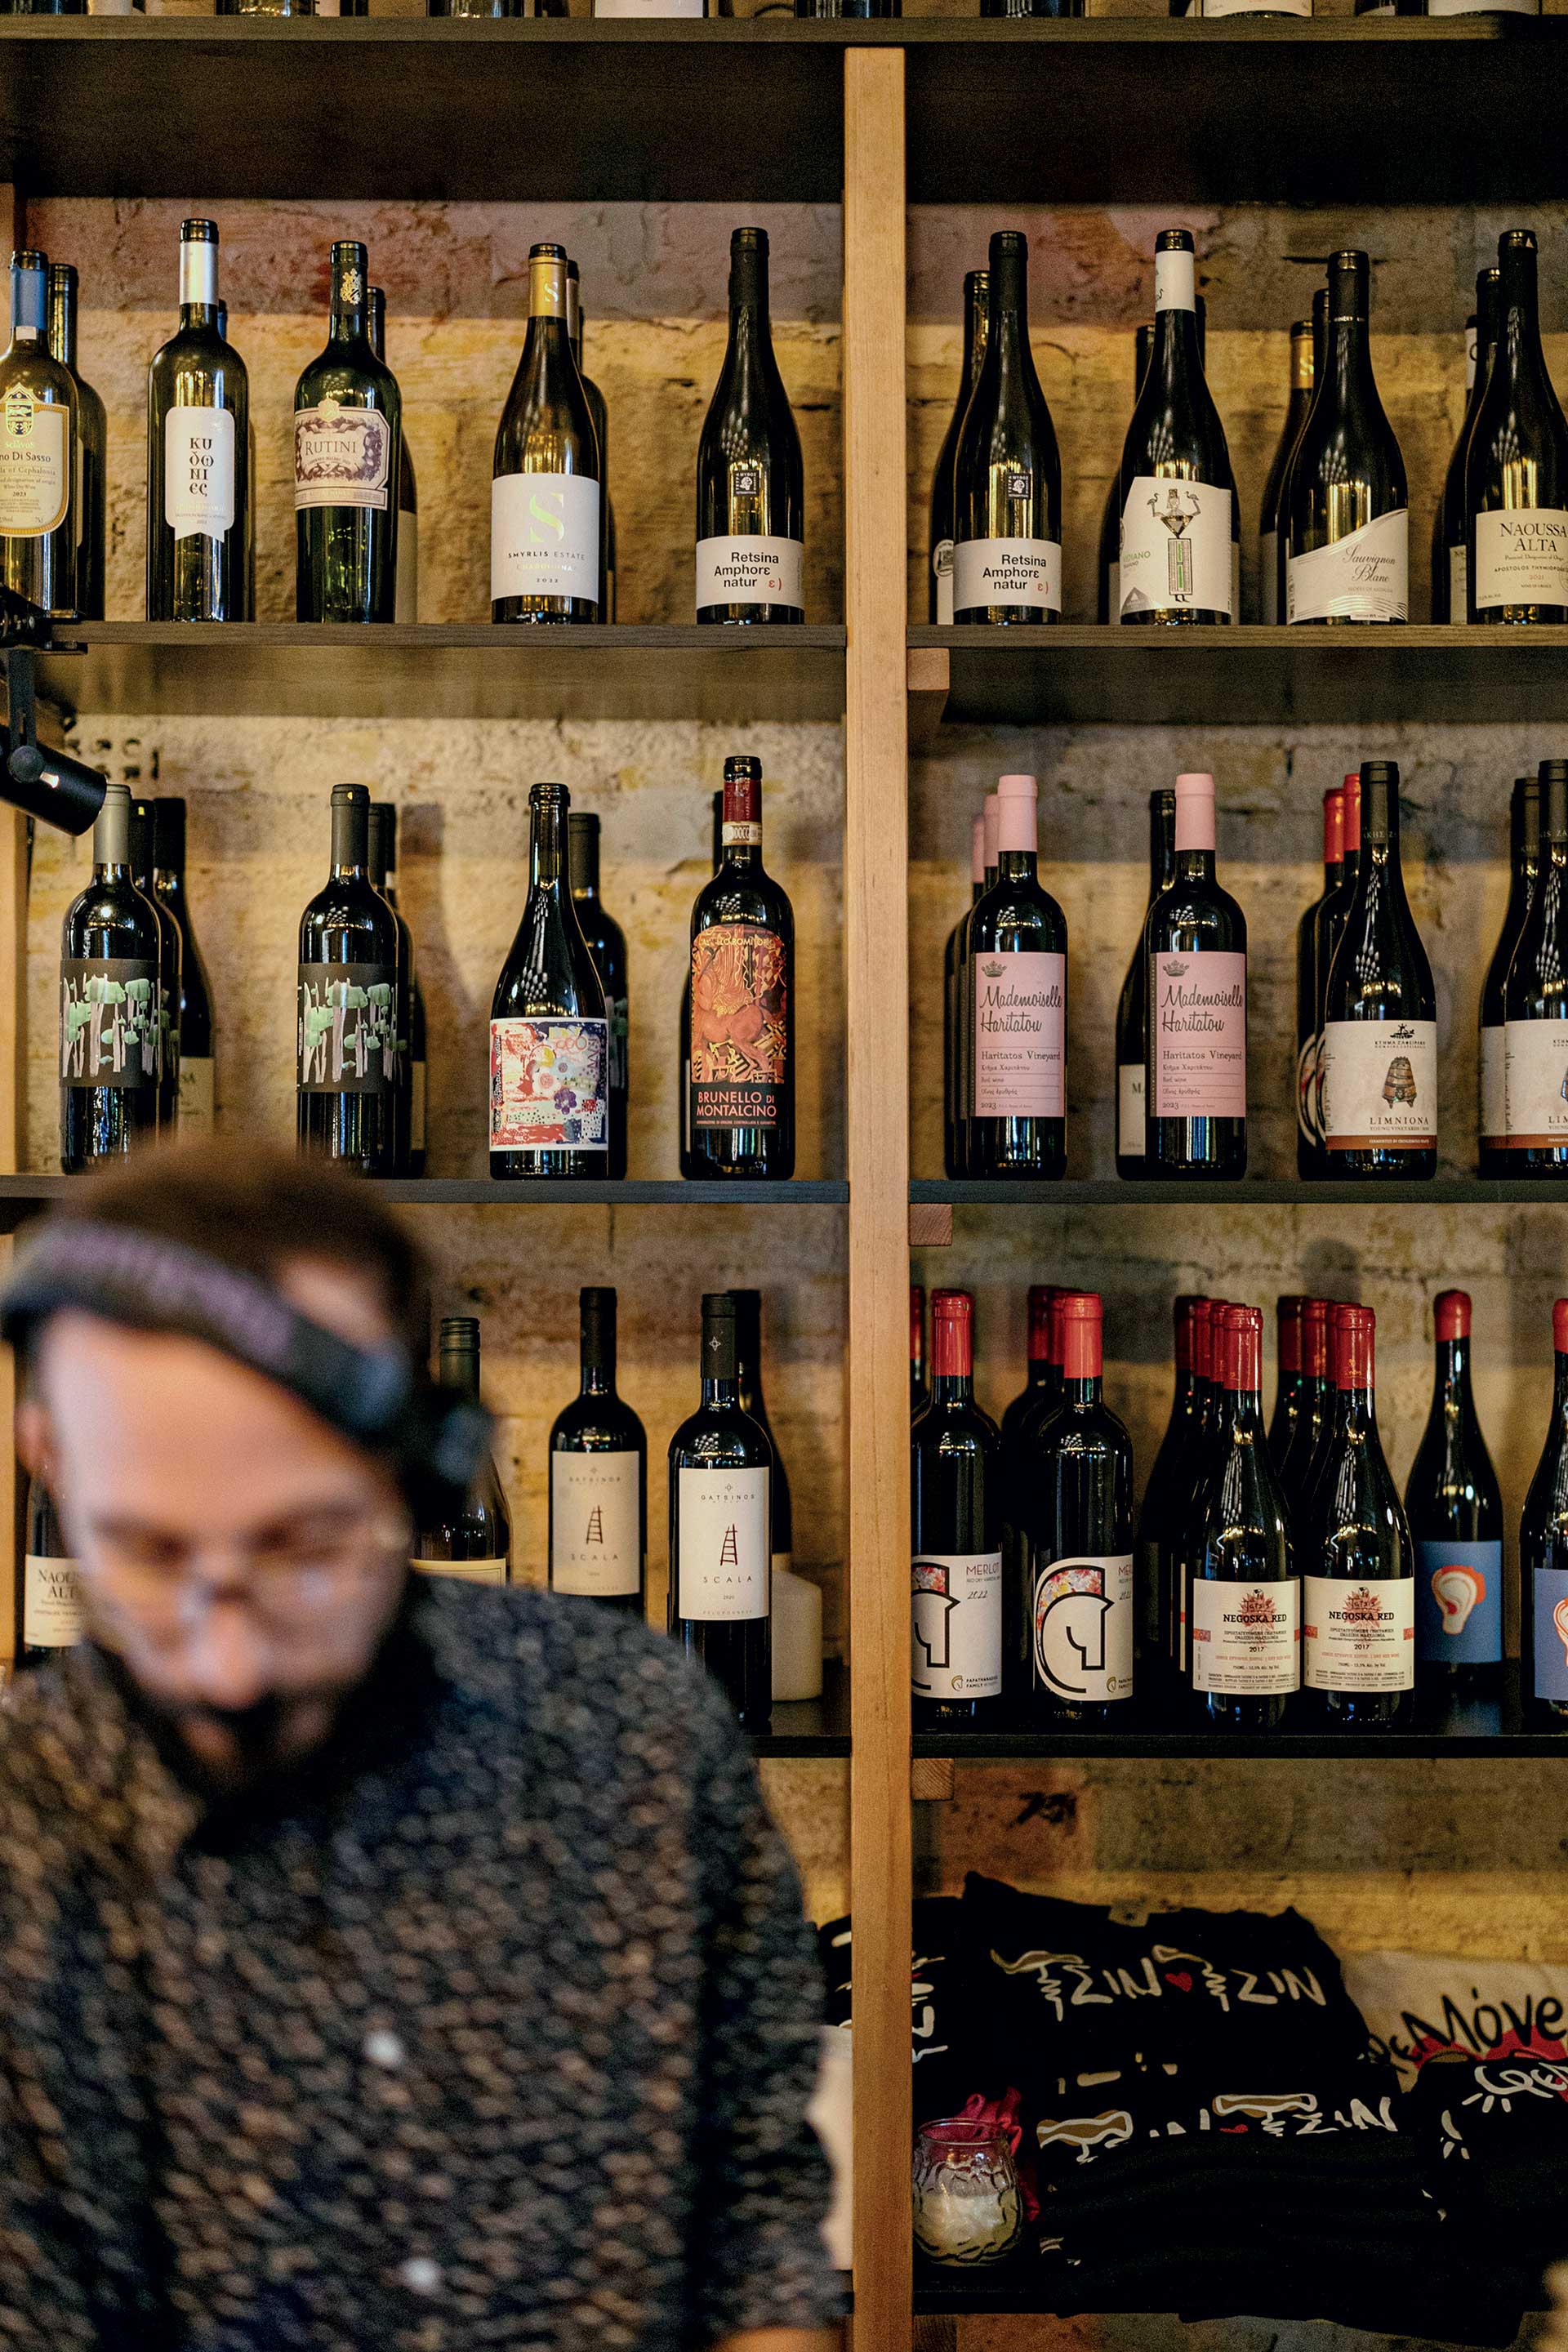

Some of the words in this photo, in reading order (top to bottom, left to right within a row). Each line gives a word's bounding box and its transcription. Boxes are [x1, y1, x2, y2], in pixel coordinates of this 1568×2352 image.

[305, 441, 356, 455] RUTINI
[12, 452, 24, 461] Di
[25, 452, 51, 462] Sasso
[1499, 522, 1568, 538] NAOUSSA
[1514, 538, 1557, 552] ALTA
[508, 550, 549, 559] SMYRLIS
[554, 550, 586, 560] ESTATE
[731, 551, 779, 564] Retsina
[1343, 544, 1396, 565] Sauvignon
[1001, 554, 1046, 568] Retsina
[1352, 564, 1389, 582] Blanc
[724, 577, 758, 588] natur
[993, 580, 1028, 590] natur
[980, 985, 1062, 1009] Mademoiselle
[1160, 984, 1243, 1009] Mademoiselle
[980, 1010, 1043, 1033] Haritatou
[1161, 1010, 1225, 1032] Haritatou
[981, 1051, 1022, 1060] Haritatos
[1163, 1050, 1205, 1060] Haritatos
[698, 1091, 762, 1103] BRUNELLO
[766, 1095, 775, 1103] DI
[697, 1105, 777, 1116] MONTALCINO
[1370, 1116, 1429, 1125] LIMNIONA
[703, 1575, 753, 1584] SCALA
[1223, 1614, 1268, 1623] NEGOSKA
[1272, 1614, 1287, 1622] RED
[1329, 1611, 1374, 1620] NEGOSKA
[1377, 1612, 1395, 1620] RED
